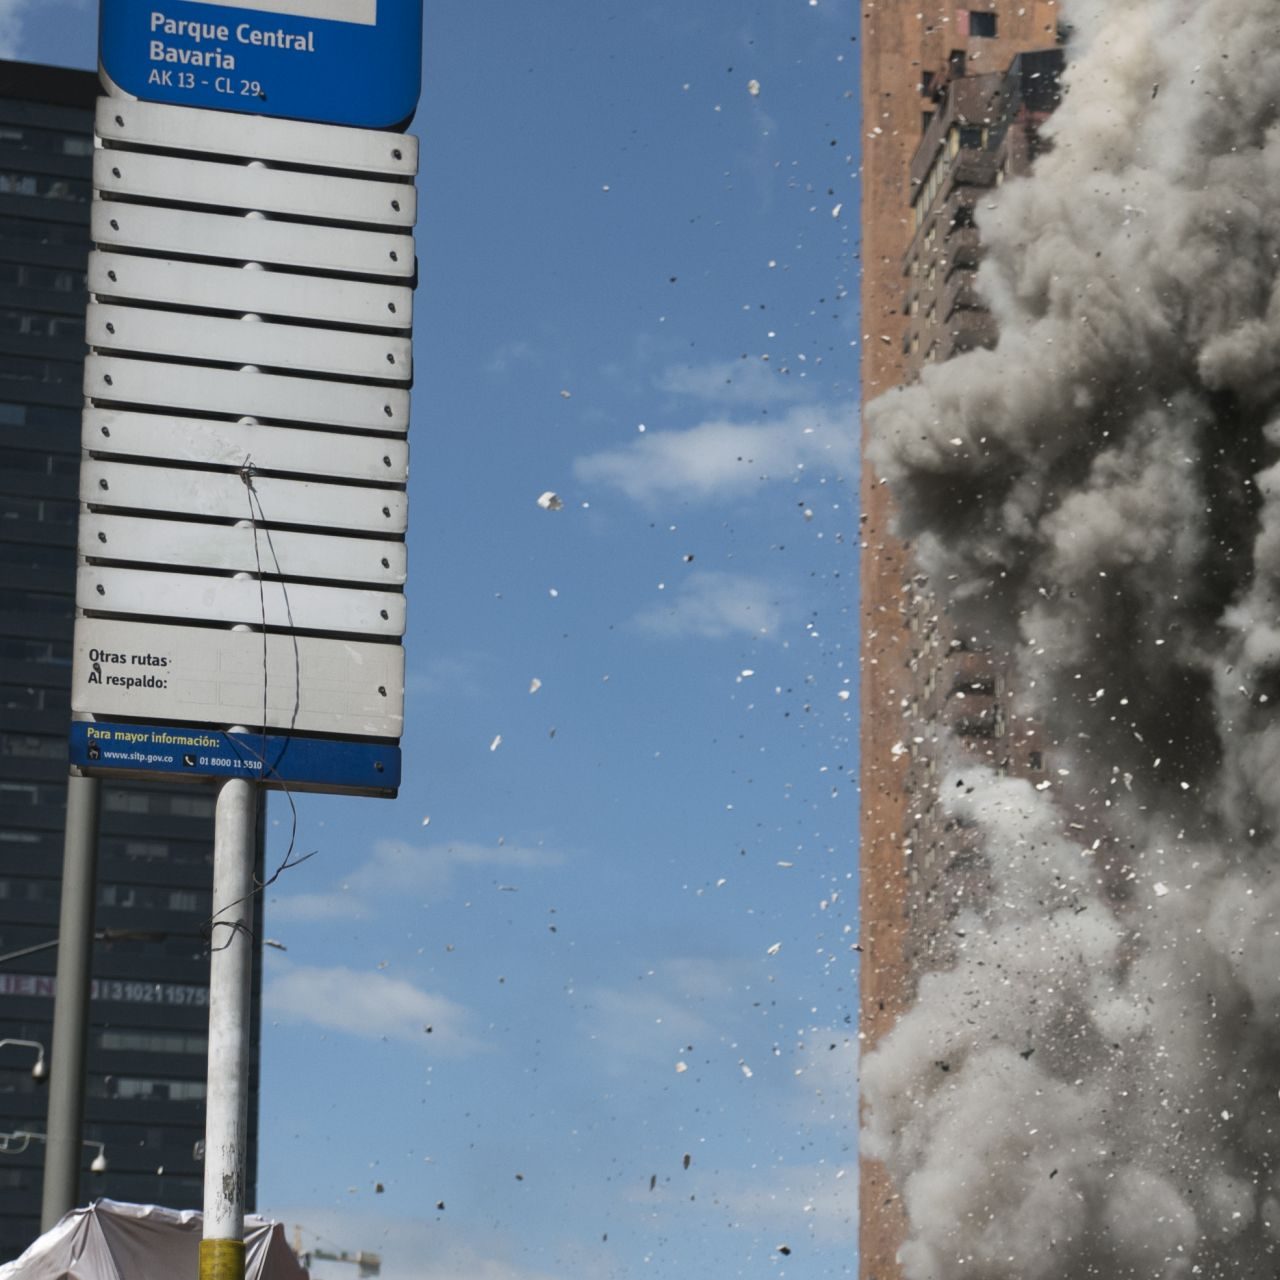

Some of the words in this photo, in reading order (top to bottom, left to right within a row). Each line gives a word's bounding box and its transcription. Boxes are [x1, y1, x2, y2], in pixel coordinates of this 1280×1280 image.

[151, 12, 229, 43] Parque
[236, 24, 315, 52] Central
[150, 40, 235, 70] Bavaria
[148, 69, 173, 87] AK
[178, 72, 195, 89] 13
[215, 77, 235, 94] CL
[89, 648, 127, 664] Otras
[131, 653, 168, 667] rutas
[88, 671, 102, 685] Al
[106, 674, 168, 690] respaldo:
[87, 727, 111, 740] Para
[114, 731, 149, 745] mayor
[151, 731, 220, 748] información:
[103, 751, 174, 764] www.sitp.gov.co
[199, 756, 209, 766] 01
[210, 757, 231, 768] 8000
[233, 759, 241, 768] 11
